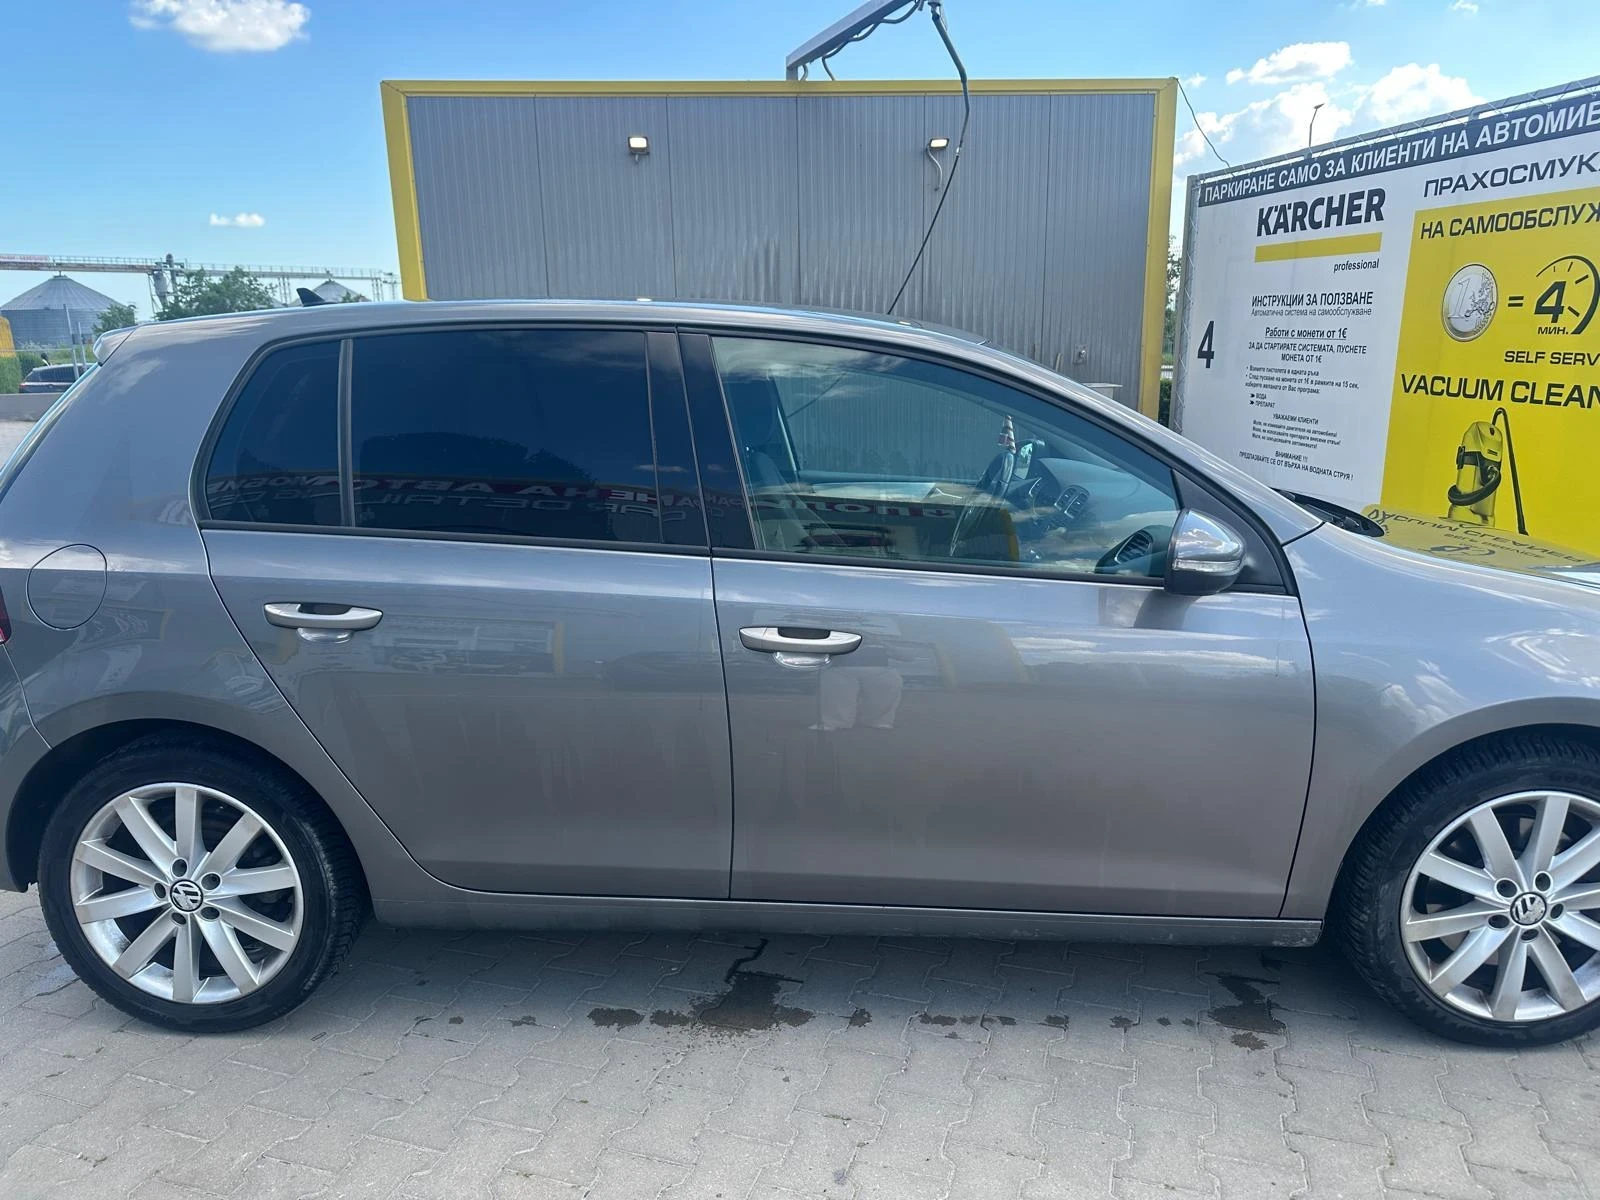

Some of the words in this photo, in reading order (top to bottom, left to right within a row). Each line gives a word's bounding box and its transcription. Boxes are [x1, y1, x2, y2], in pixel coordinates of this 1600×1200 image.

[1204, 172, 1276, 203] ПАРКИРАНЕ
[1278, 164, 1321, 188] САМО
[1324, 157, 1346, 178] ЗА
[1350, 137, 1437, 173] КЛИЕНТИ
[1440, 129, 1470, 156] НА
[1423, 151, 1600, 198] ПРАХОСМУК
[1256, 187, 1386, 237] KÄRCHER
[1420, 220, 1445, 240] НА
[1449, 202, 1600, 237] САМООБСЛУЖ
[1333, 258, 1380, 274] professional
[1251, 294, 1304, 308] ИНСТРУКЦИИ
[1305, 293, 1318, 306] ЗА
[1320, 291, 1374, 306] ПОЛЗВАНЕ
[1534, 280, 1567, 324] 4
[1251, 308, 1284, 317] Автоматична
[1317, 306, 1372, 318] самообслужване
[1265, 326, 1290, 337] Работи
[1290, 329, 1296, 337] с
[1296, 329, 1325, 338] монети
[1326, 330, 1336, 338] от
[1337, 327, 1348, 339] 1€
[1537, 326, 1569, 335] МИН.
[1197, 320, 1215, 369] 4
[1248, 341, 1255, 350] ЗА
[1255, 342, 1263, 350] ДА
[1263, 342, 1297, 351] СТАРТИРАТЕ
[1297, 343, 1335, 353] СИСТЕМАТА,
[1336, 344, 1367, 354] ПУСНЕТЕ
[1281, 353, 1304, 362] МОНЕТА
[1305, 354, 1314, 362] ОТ
[1315, 355, 1322, 363] 1€
[1503, 350, 1546, 364] SELF
[1549, 351, 1600, 366] SERV
[1400, 373, 1504, 402] VACUUM
[1274, 450, 1302, 462] ВНИМАНИЕ
[1277, 459, 1284, 467] ОТ
[1284, 460, 1301, 470] ВЪРХА
[1309, 465, 1332, 477] ВОДНАТА
[1333, 470, 1351, 480] СТРУЯ
